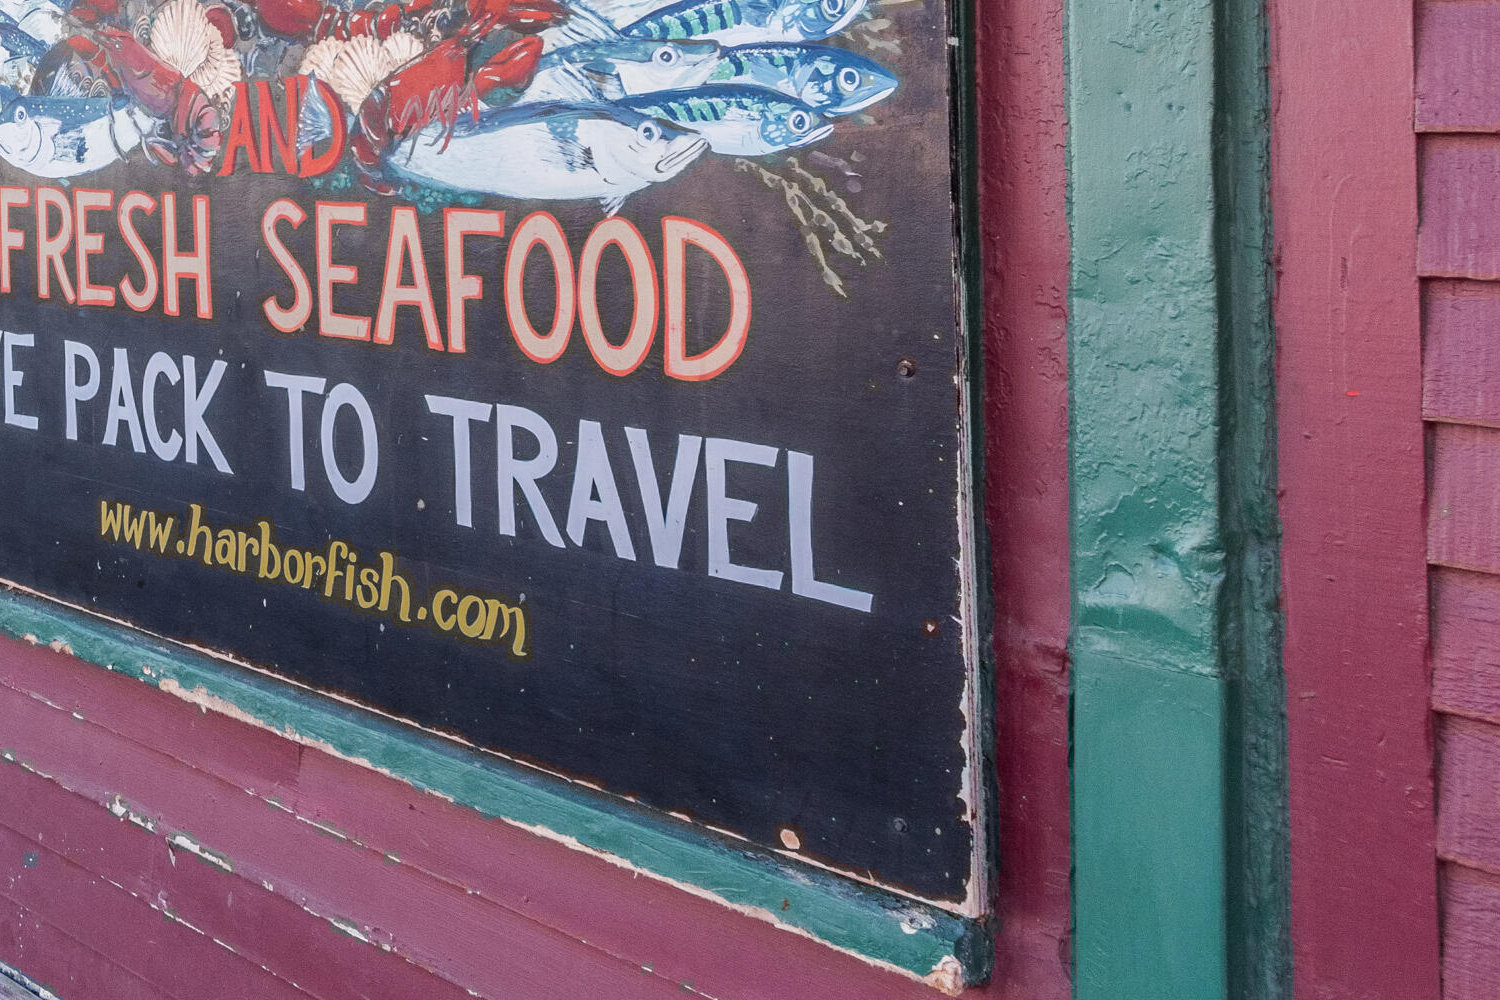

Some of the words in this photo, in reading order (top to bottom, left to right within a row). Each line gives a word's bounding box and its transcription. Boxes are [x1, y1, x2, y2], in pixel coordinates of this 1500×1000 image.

[217, 75, 347, 178] AND
[0, 185, 212, 319] FRESH
[261, 198, 752, 381] SEAFOOD
[64, 340, 235, 475] PACK
[264, 369, 378, 504] TO
[424, 394, 874, 613] TRAVEL
[100, 500, 527, 656] www.harborfish.com
